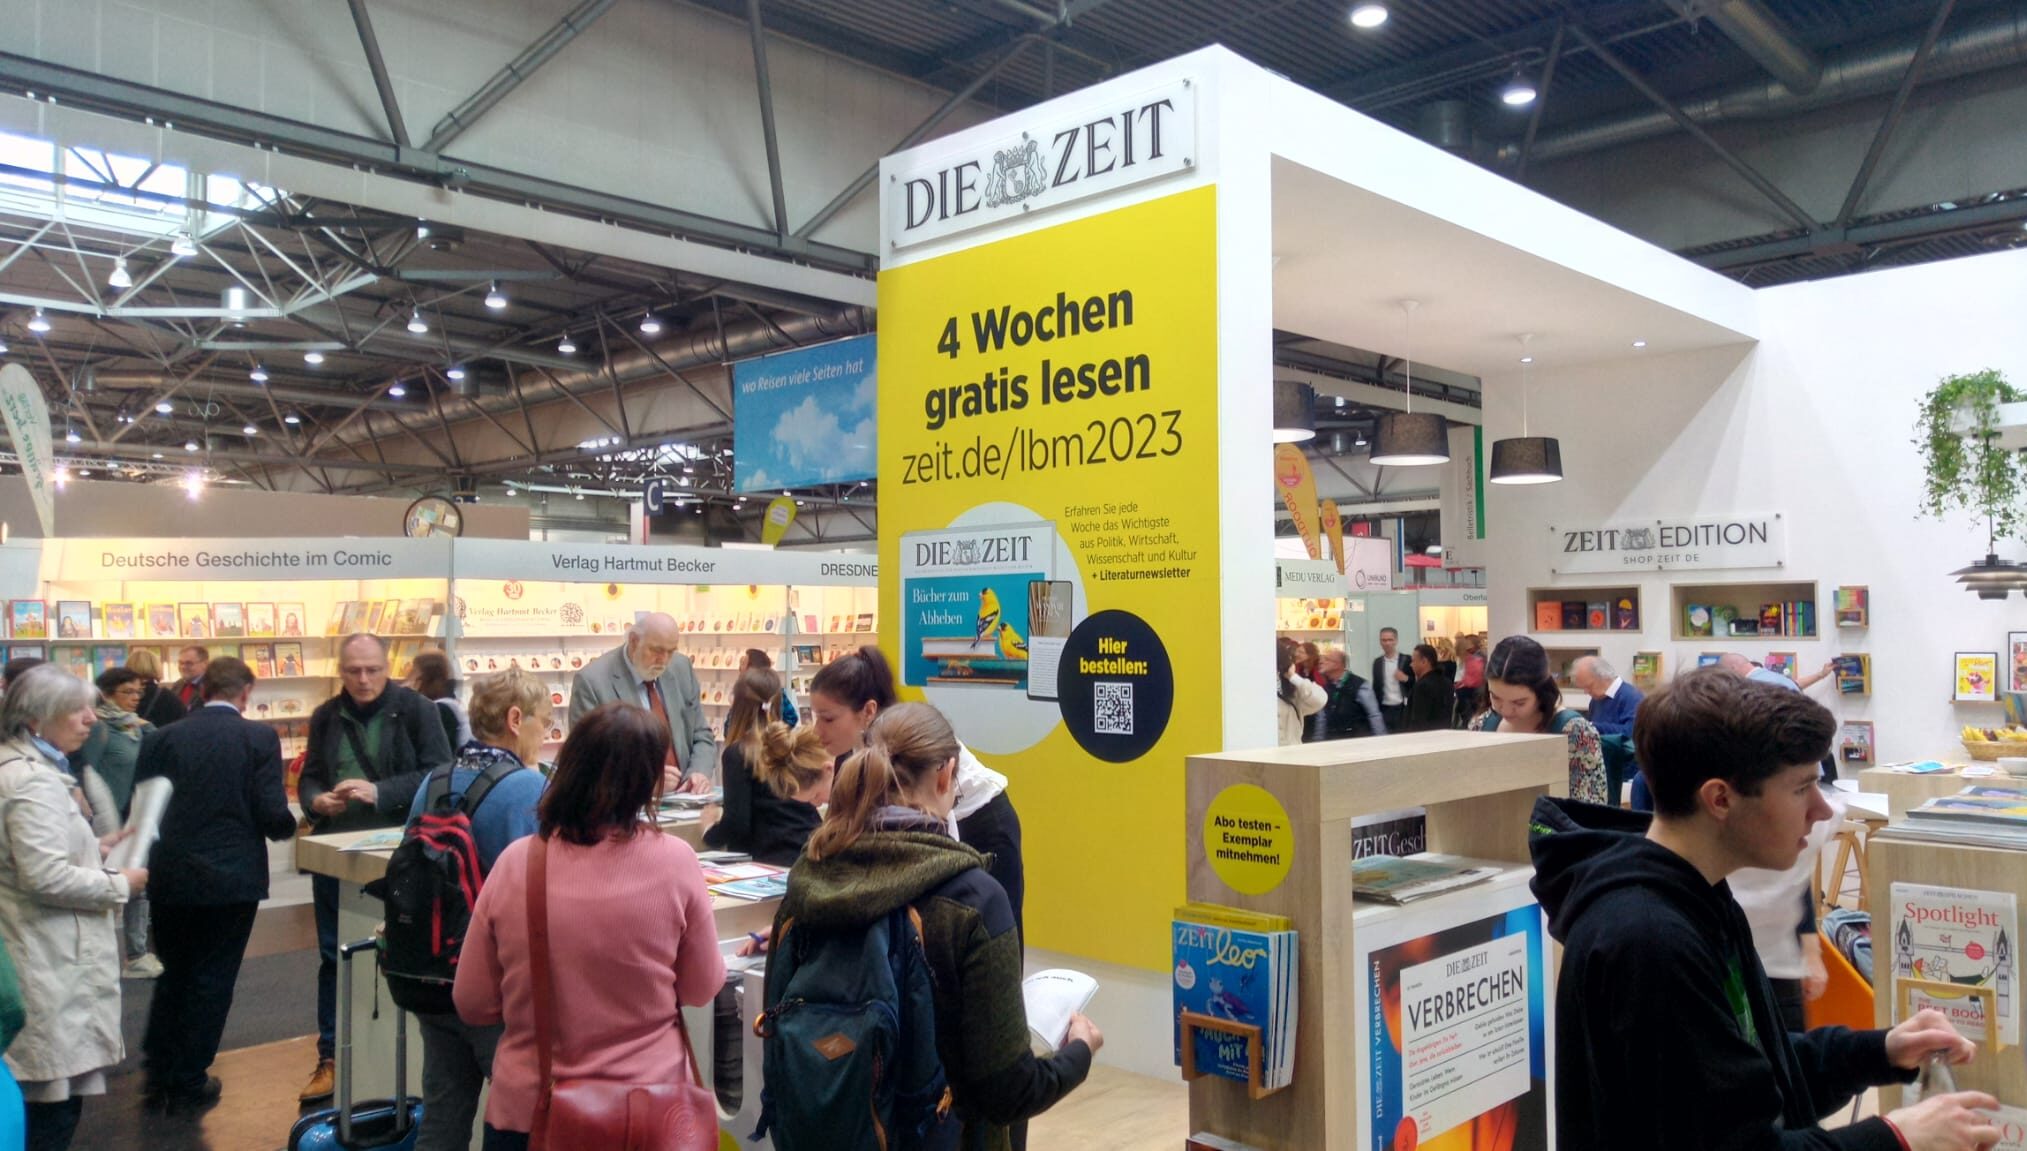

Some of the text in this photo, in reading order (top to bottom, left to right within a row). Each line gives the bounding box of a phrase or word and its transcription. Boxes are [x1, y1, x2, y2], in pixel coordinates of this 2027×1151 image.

[904, 99, 1174, 231] DIE ZEIT
[937, 289, 1134, 359] 4 Wochen
[742, 358, 864, 393] wo Reisen viele Seiten hat
[925, 353, 1150, 430] gratis lesen
[902, 410, 1183, 485] zeit.de/lbm2023
[647, 481, 660, 512] C
[1064, 502, 1138, 518] Erfahren Sie jede
[1071, 517, 1170, 533] Woche das Wichtigste
[1079, 532, 1179, 549] aus Politik, Wirtschaft,
[1563, 522, 1767, 553] ZEIT EDITION
[101, 549, 392, 569] Deutsche Geschichte im Comic
[915, 535, 1032, 567] DIE ZEIT
[1087, 549, 1197, 564] Wissenschaft und Kultur
[552, 554, 716, 573] Verlag Hartmut Becker
[1100, 567, 1191, 581] Literaturnewsletter
[1285, 571, 1335, 584] MEDU VERLAG
[913, 587, 969, 603] Bücher zum
[919, 609, 963, 625] Abheben
[1098, 637, 1128, 655] Hier
[1079, 657, 1148, 676] bestellen:
[1214, 815, 1236, 828] Abo
[1238, 818, 1272, 832] testen
[1222, 832, 1273, 849] Exemplar
[1216, 848, 1280, 866] mitnehmen!
[1905, 902, 2000, 929] Spotlight
[1178, 926, 1269, 969] ZEIT leo
[1446, 959, 1461, 978] DIE
[1471, 951, 1489, 969] ZEIT
[1373, 960, 1383, 1046] VERBRECHEN
[1408, 965, 1523, 1032] VERBRECHEN
